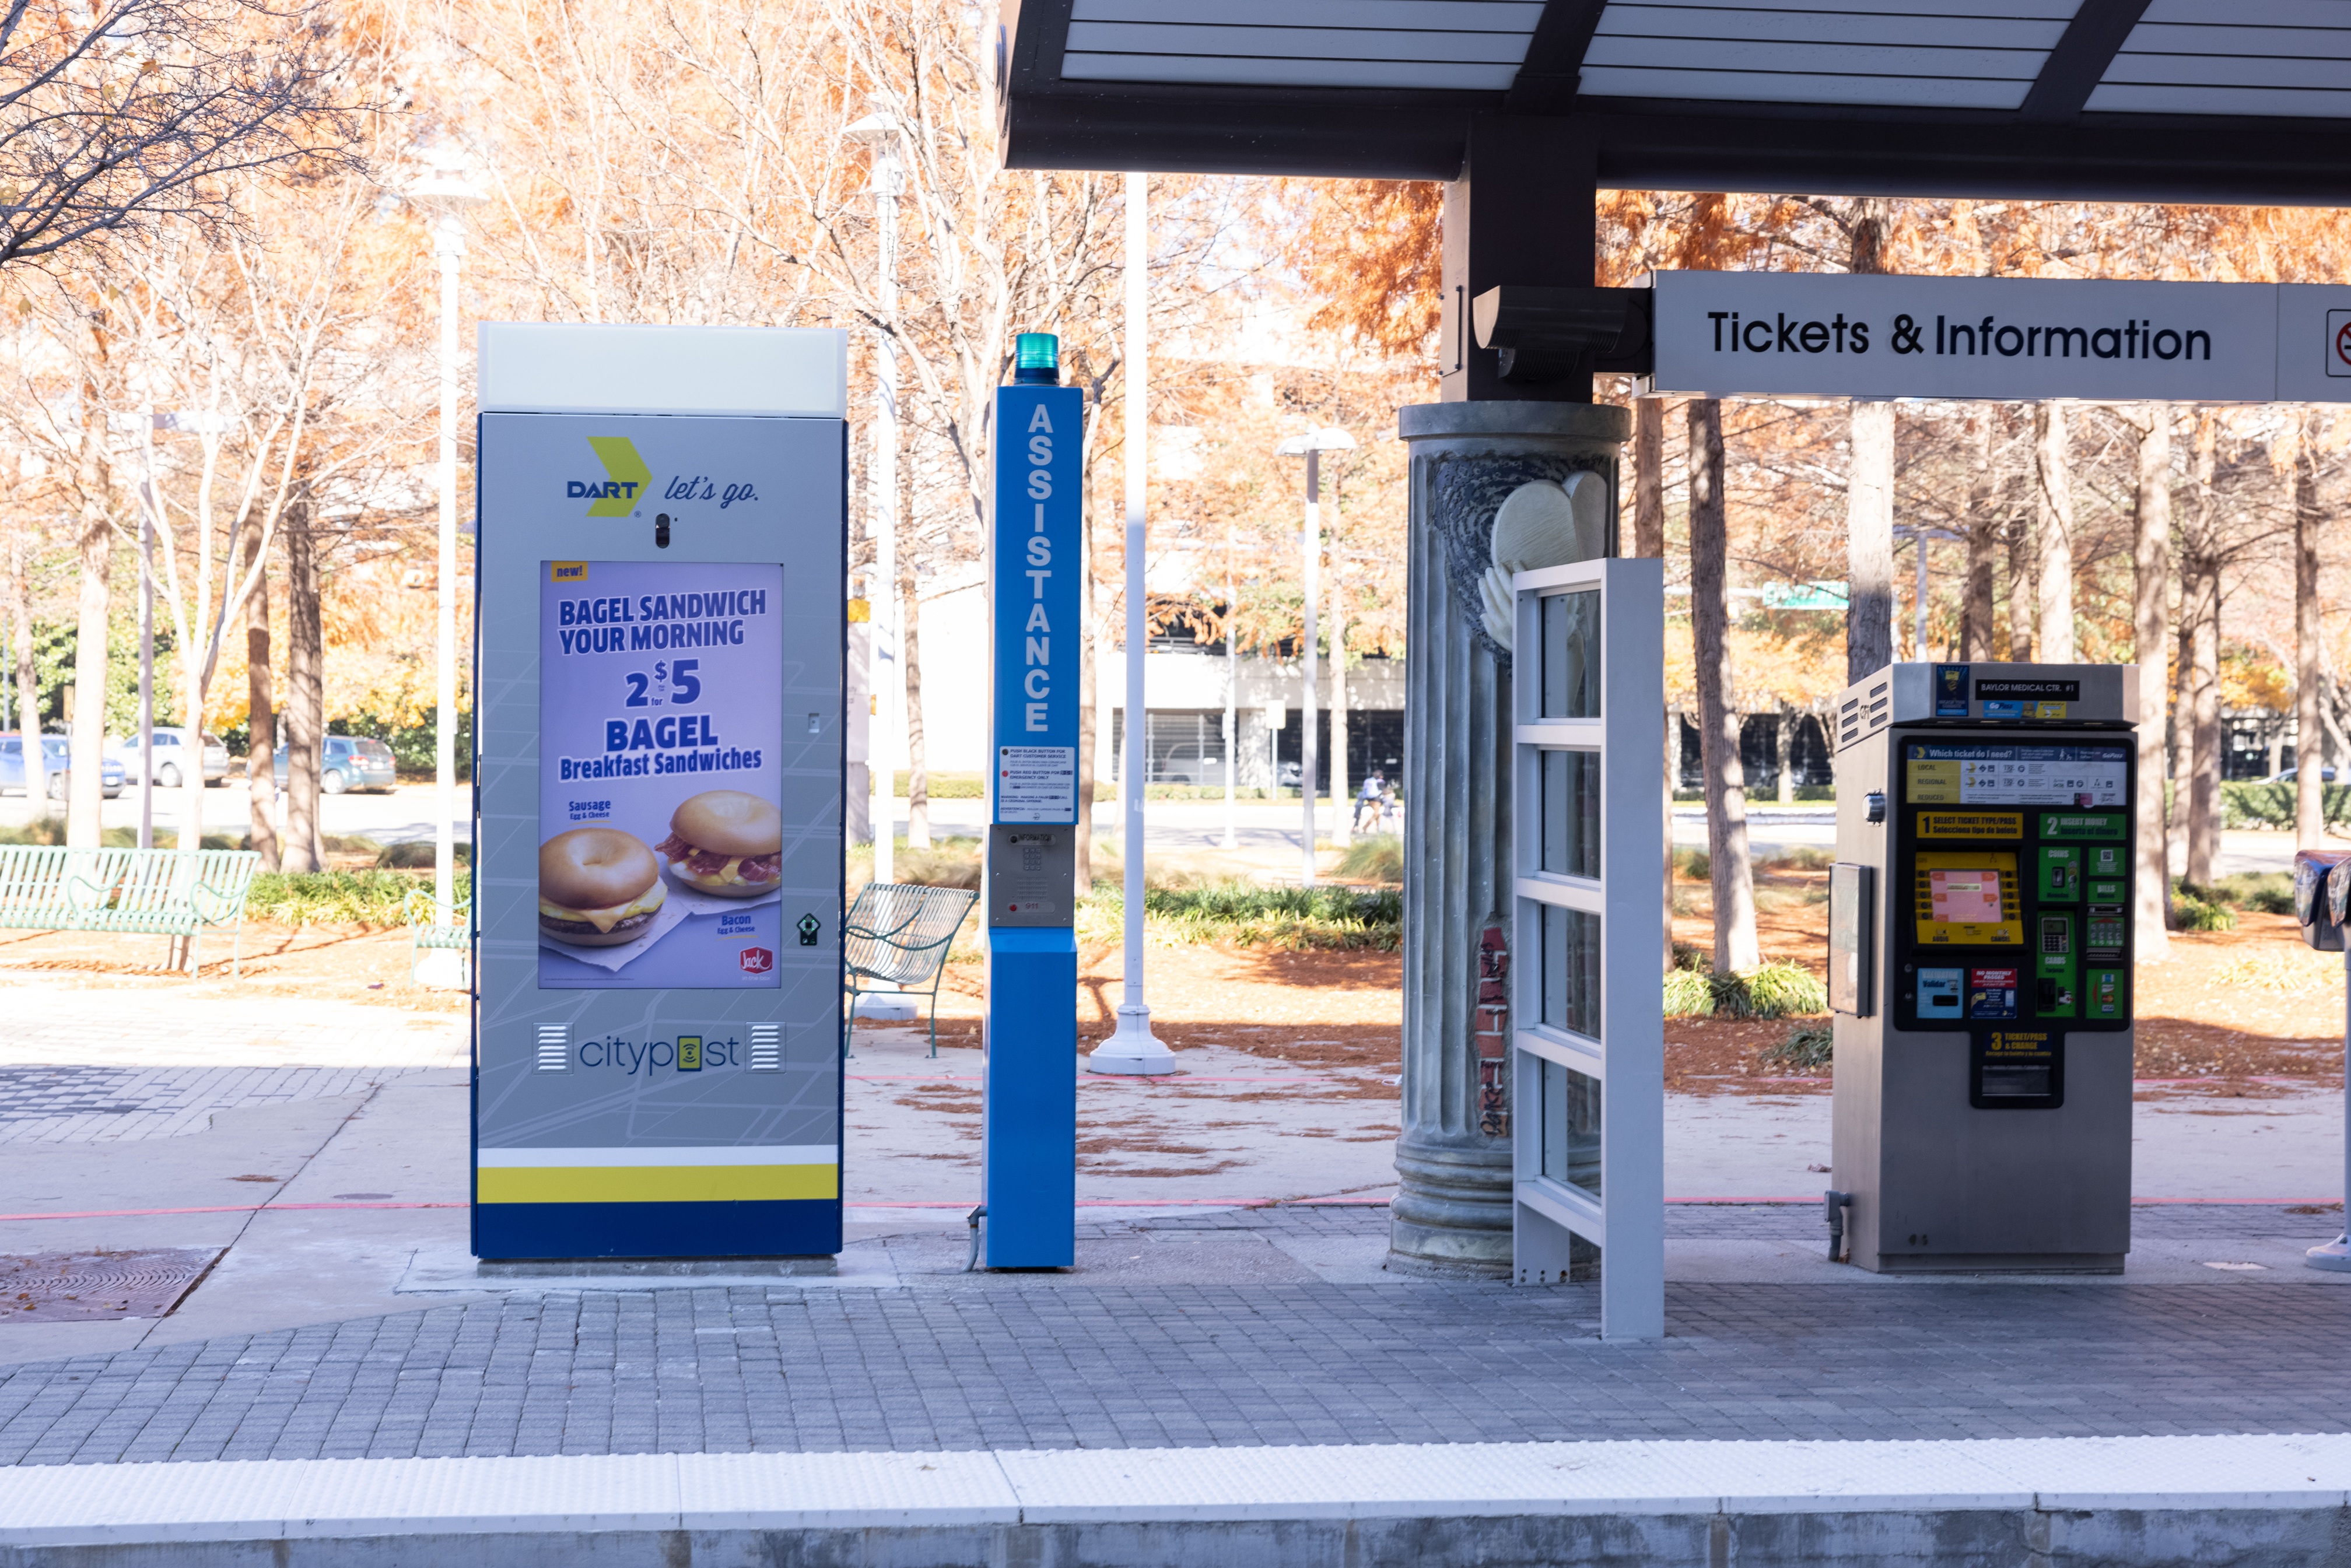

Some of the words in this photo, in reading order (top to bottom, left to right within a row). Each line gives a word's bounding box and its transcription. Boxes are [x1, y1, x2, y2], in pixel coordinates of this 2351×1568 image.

[1708, 310, 1870, 353] Tickets
[1891, 314, 1924, 355] &
[1936, 315, 2212, 361] Information
[567, 480, 638, 499] DART
[664, 475, 716, 500] let's
[720, 483, 759, 509] go.
[556, 565, 583, 577] new!
[1025, 404, 1053, 732] ASSISTANCE
[559, 597, 635, 626] BAGEL
[640, 589, 766, 622] SANDWICH
[559, 626, 625, 655] YOUR
[630, 619, 744, 651] MORNING
[625, 672, 649, 707] 2
[651, 697, 663, 706] for
[1981, 683, 2009, 692] BAYLOR
[2010, 683, 2044, 692] MEDICAL
[2045, 683, 2062, 692] CTR.
[2065, 683, 2075, 692] #1
[1989, 702, 2013, 710] GoPass
[606, 714, 719, 752] BAGEL
[1929, 749, 1953, 757] Which
[1954, 749, 1976, 758] ticket
[1976, 750, 1985, 758] do
[1991, 750, 2013, 758] need?
[560, 755, 649, 780] Breakfast
[654, 747, 762, 774] Sandwiches
[569, 800, 611, 812] Sausage
[1922, 816, 1930, 834] 1
[1981, 817, 2017, 825] TYPE/PASS
[2047, 816, 2058, 836] 2
[2060, 818, 2083, 826] INSERT
[2084, 818, 2108, 826] MONEY
[1933, 826, 1971, 834] Selecciona
[1986, 826, 1995, 834] de
[2048, 850, 2069, 858] COINS
[2097, 885, 2116, 893] BILLS
[721, 915, 751, 925] Bacon
[741, 949, 772, 970] Jack
[2045, 956, 2066, 965] CARDS
[1922, 980, 1947, 988] Validar
[1991, 1032, 2003, 1051] 3
[2004, 1033, 2048, 1041] TICKET/PASS
[2011, 1041, 2038, 1050] CHANGE
